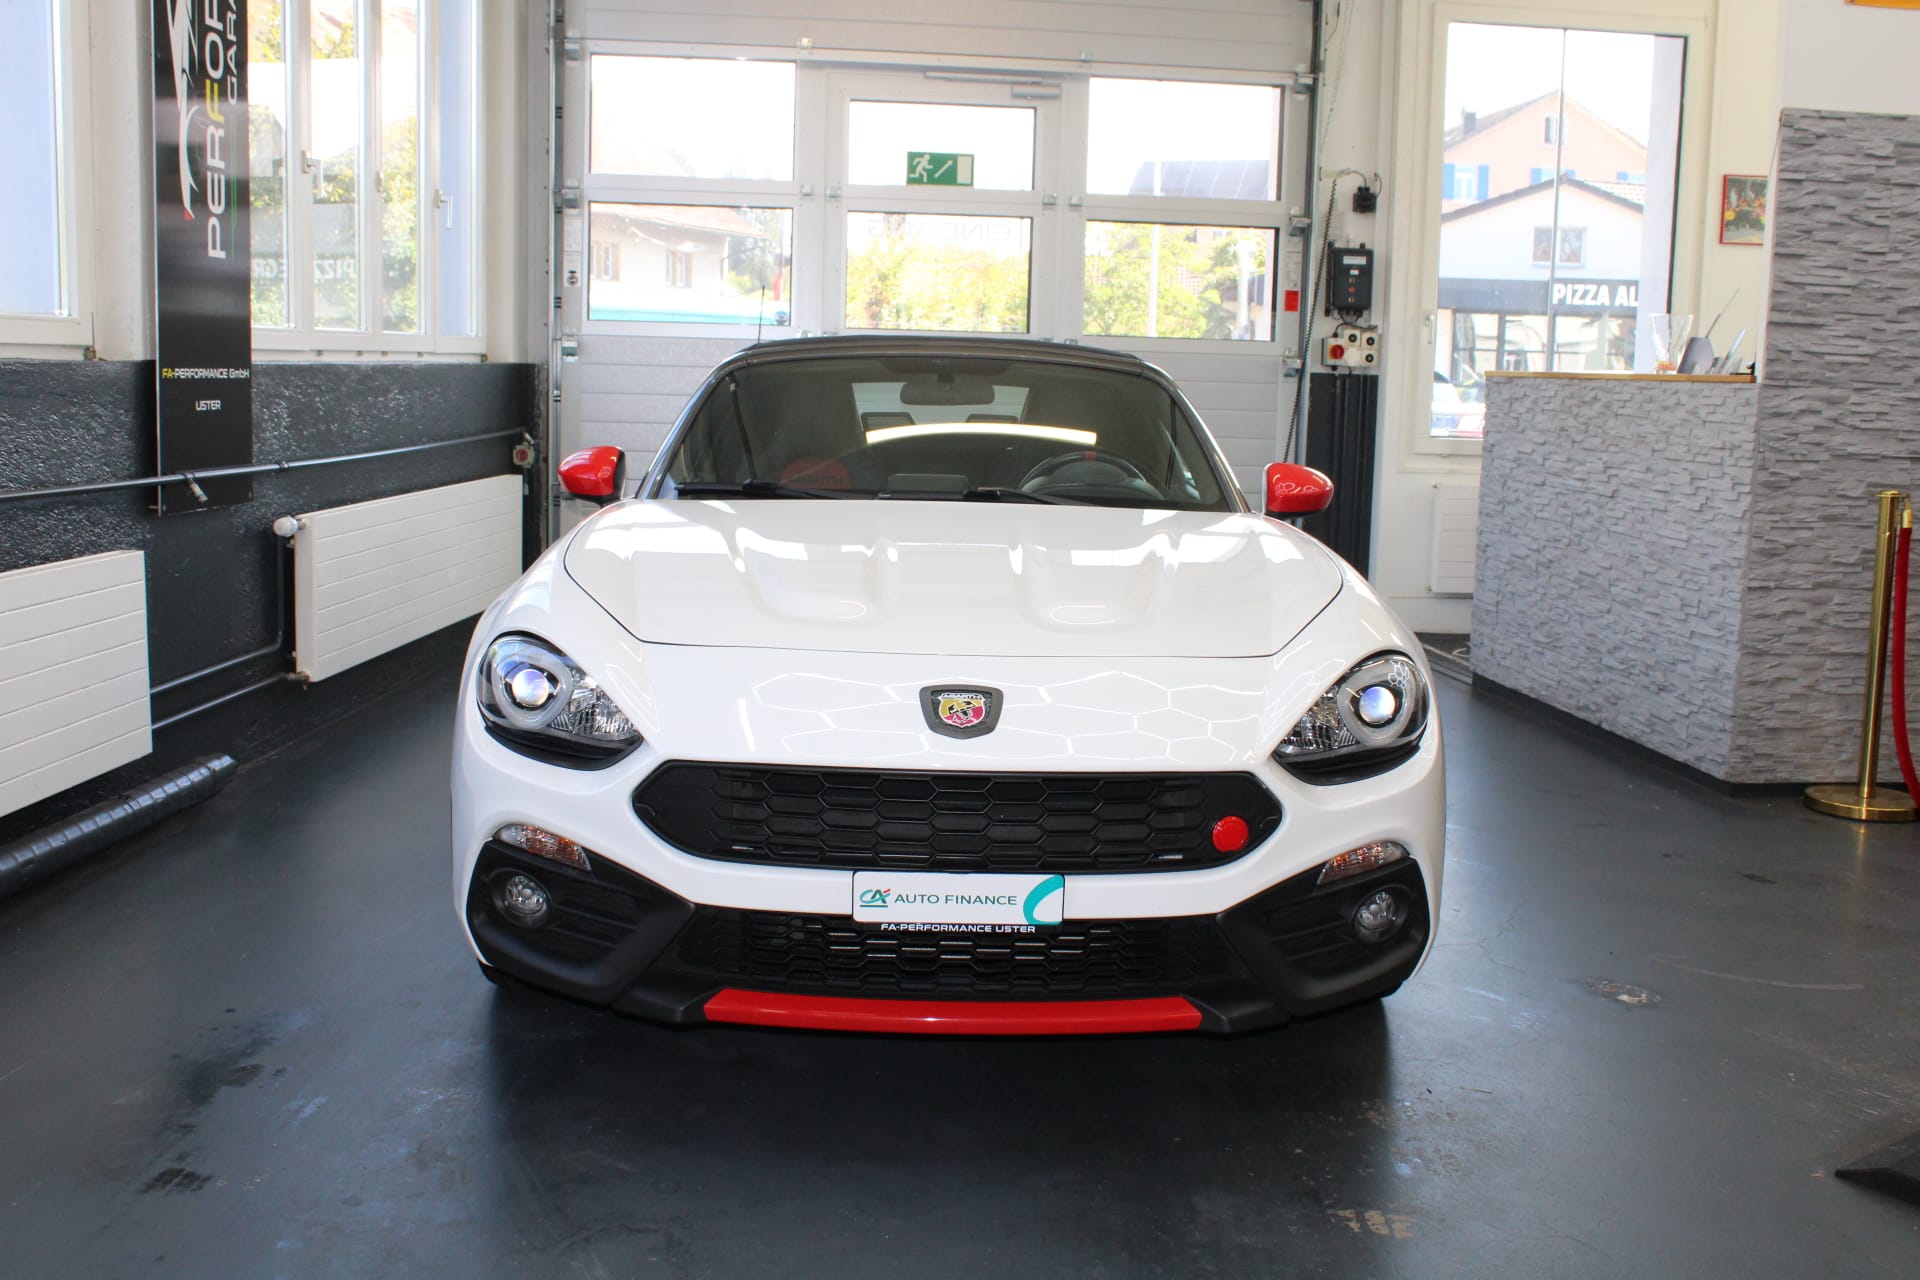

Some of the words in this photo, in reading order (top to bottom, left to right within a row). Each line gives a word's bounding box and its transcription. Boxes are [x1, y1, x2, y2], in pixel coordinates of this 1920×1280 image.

[1552, 283, 1610, 306] PIZZA
[162, 368, 228, 379] FA-PERFORMANCE
[229, 368, 250, 379] GmbH
[195, 400, 221, 411] USTER
[894, 893, 940, 905] AUTO
[945, 894, 1018, 906] FINANCE
[881, 923, 992, 933] FA-PERFORMANCE
[995, 924, 1036, 934] USTER
